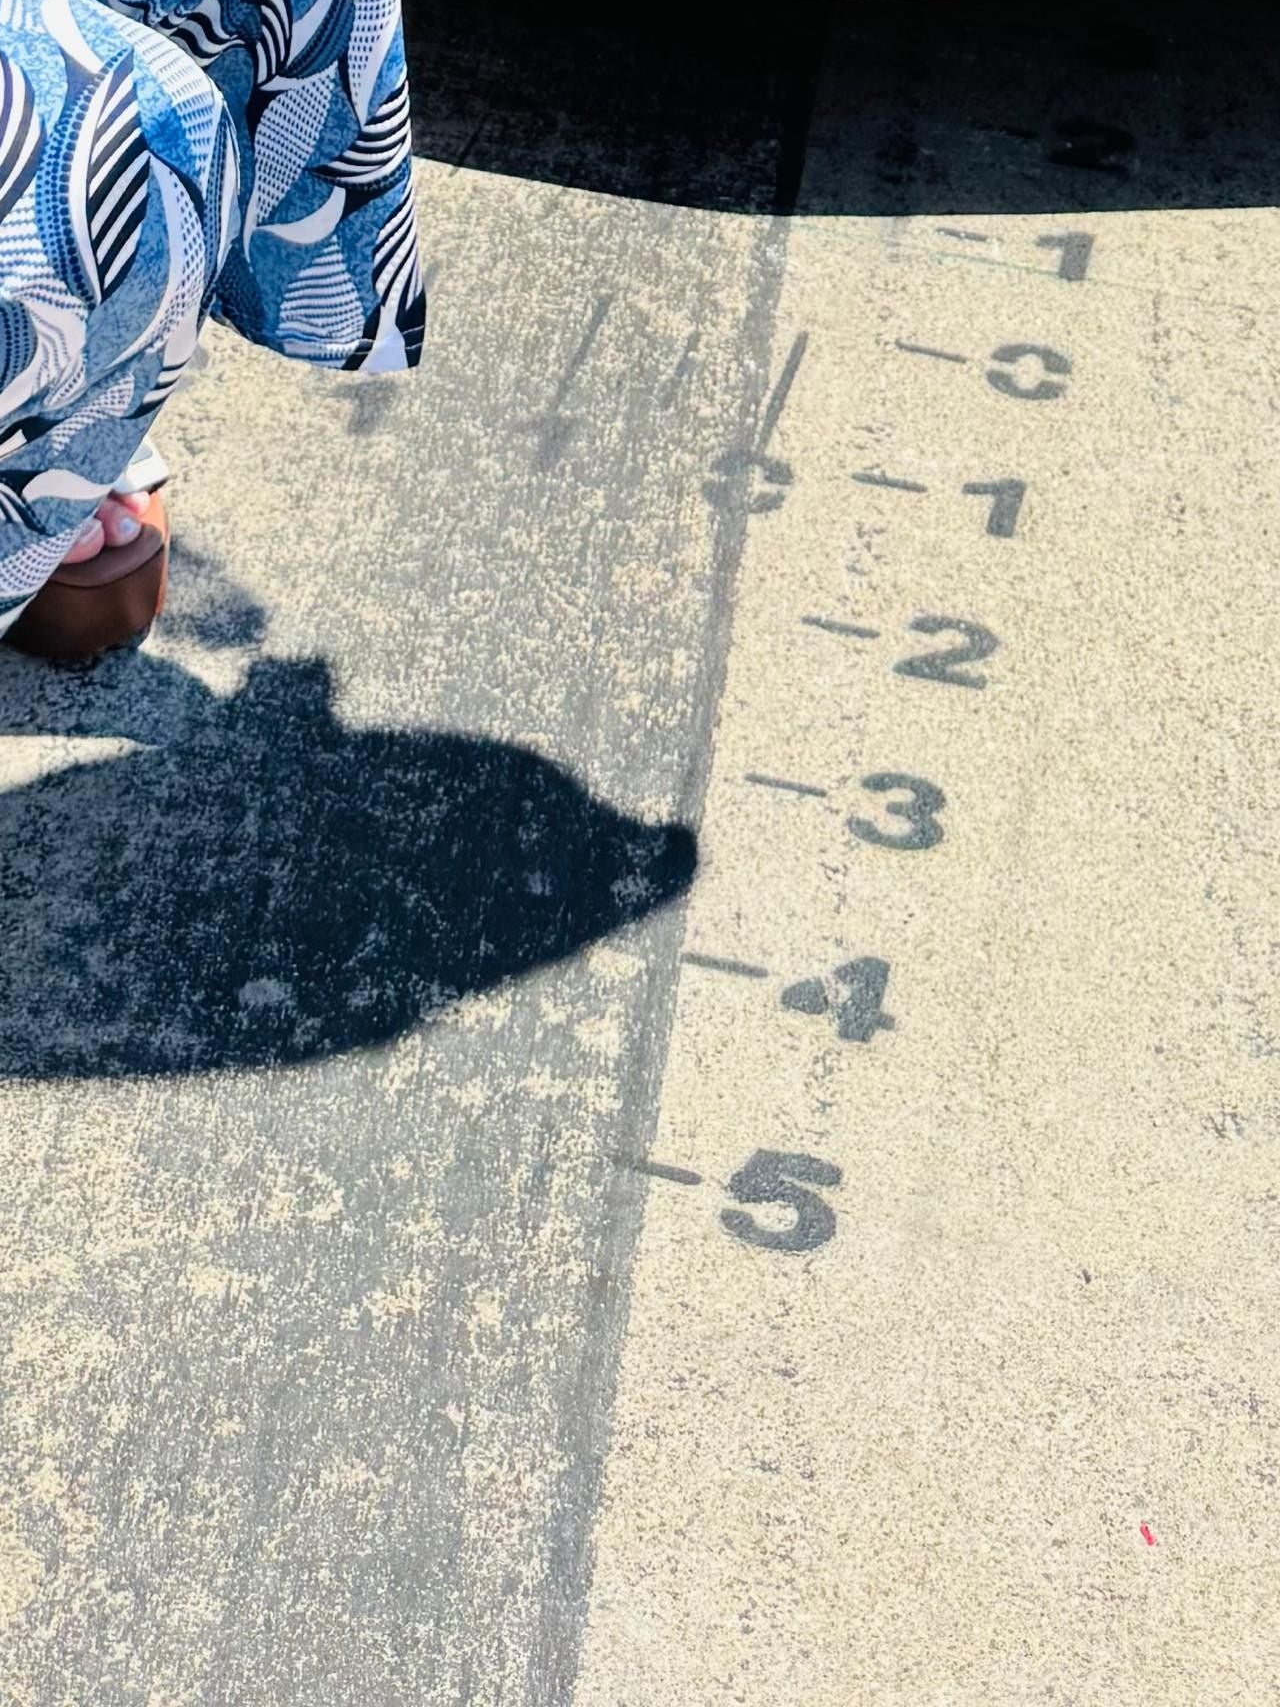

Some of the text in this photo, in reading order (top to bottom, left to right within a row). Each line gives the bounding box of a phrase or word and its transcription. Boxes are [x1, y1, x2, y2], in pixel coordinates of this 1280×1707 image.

[1036, 231, 1097, 282] 1
[984, 342, 1076, 402] 0
[961, 478, 1031, 539] 1
[893, 614, 1000, 689] 2
[847, 770, 947, 851] 3
[778, 954, 898, 1044] 4
[717, 1146, 844, 1254] 5
